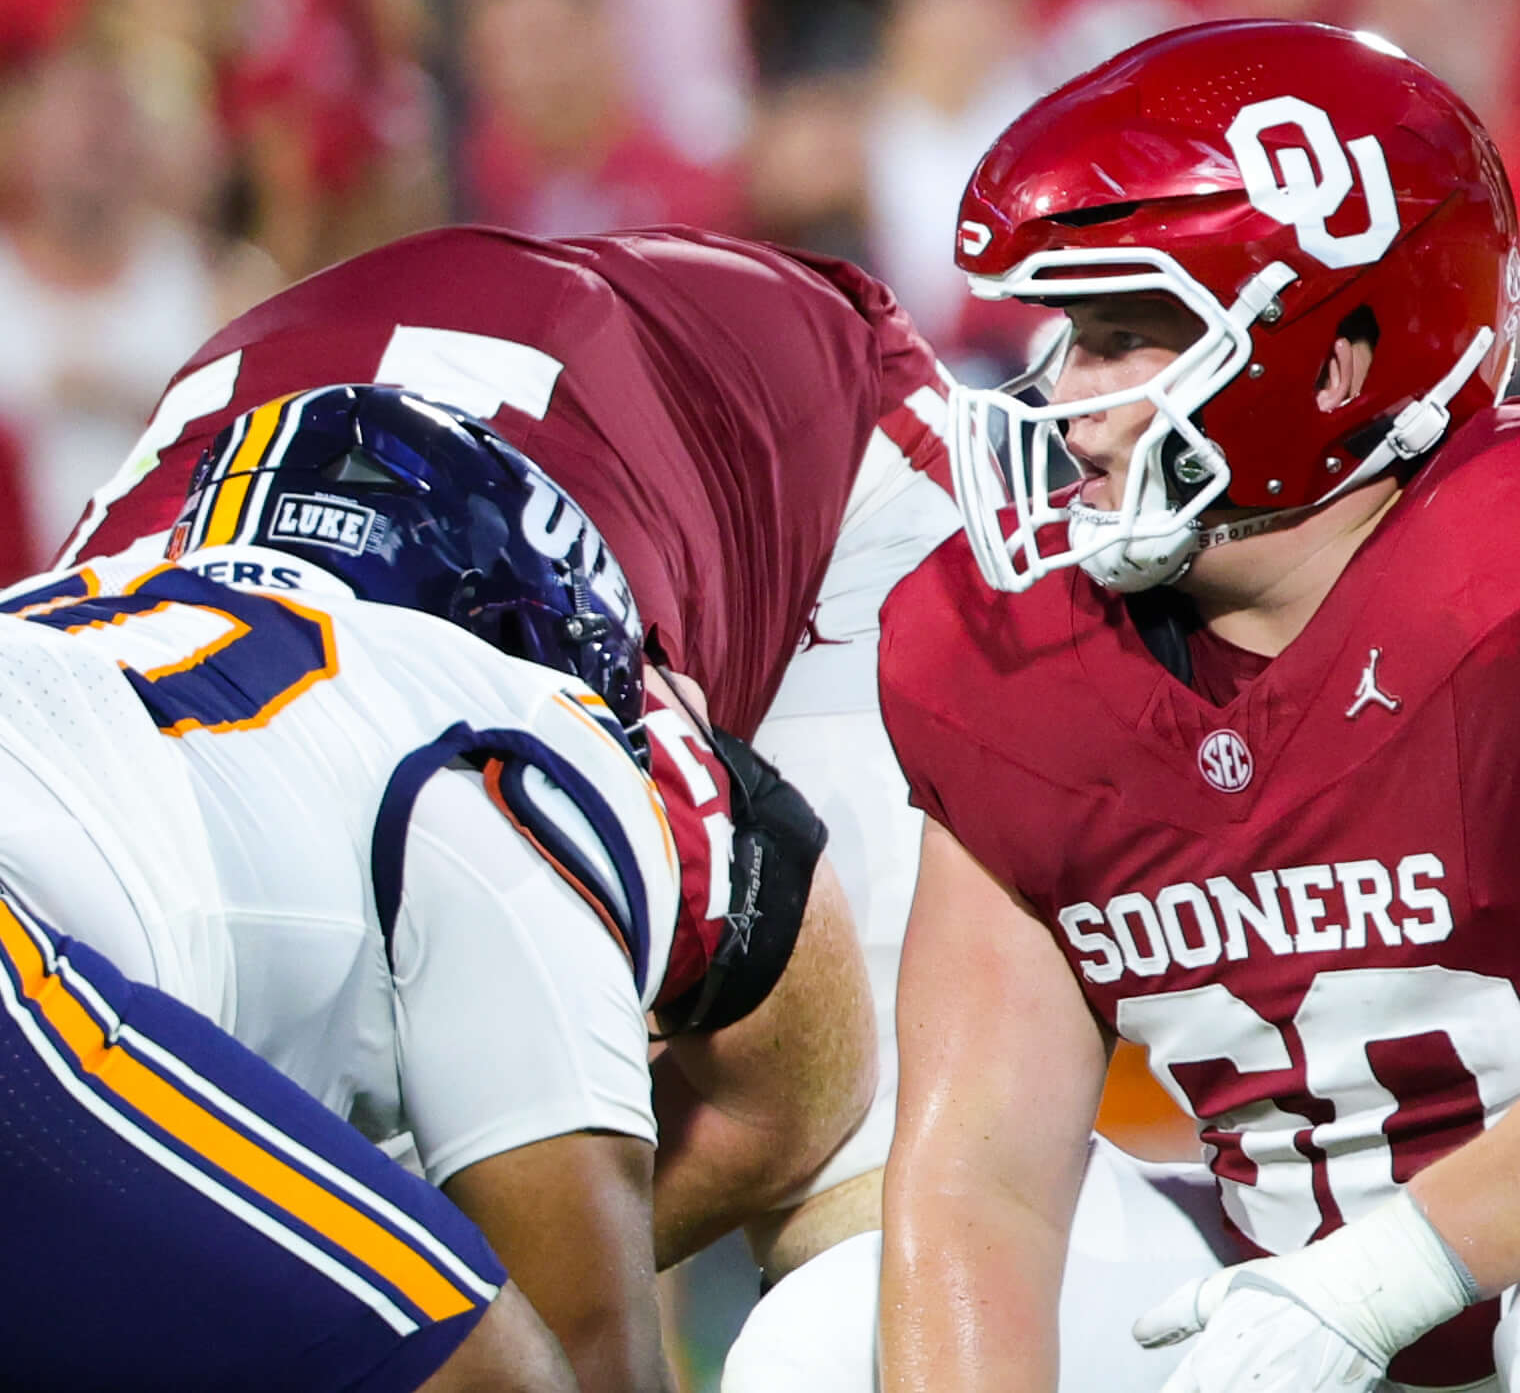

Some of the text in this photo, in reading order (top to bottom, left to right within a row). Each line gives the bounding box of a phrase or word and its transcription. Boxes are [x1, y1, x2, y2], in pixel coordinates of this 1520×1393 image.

[1224, 95, 1401, 270] OU
[277, 502, 366, 545] LUKE
[192, 561, 302, 590] ERS
[1202, 733, 1249, 788] SEC
[1058, 852, 1453, 984] SOONERS
